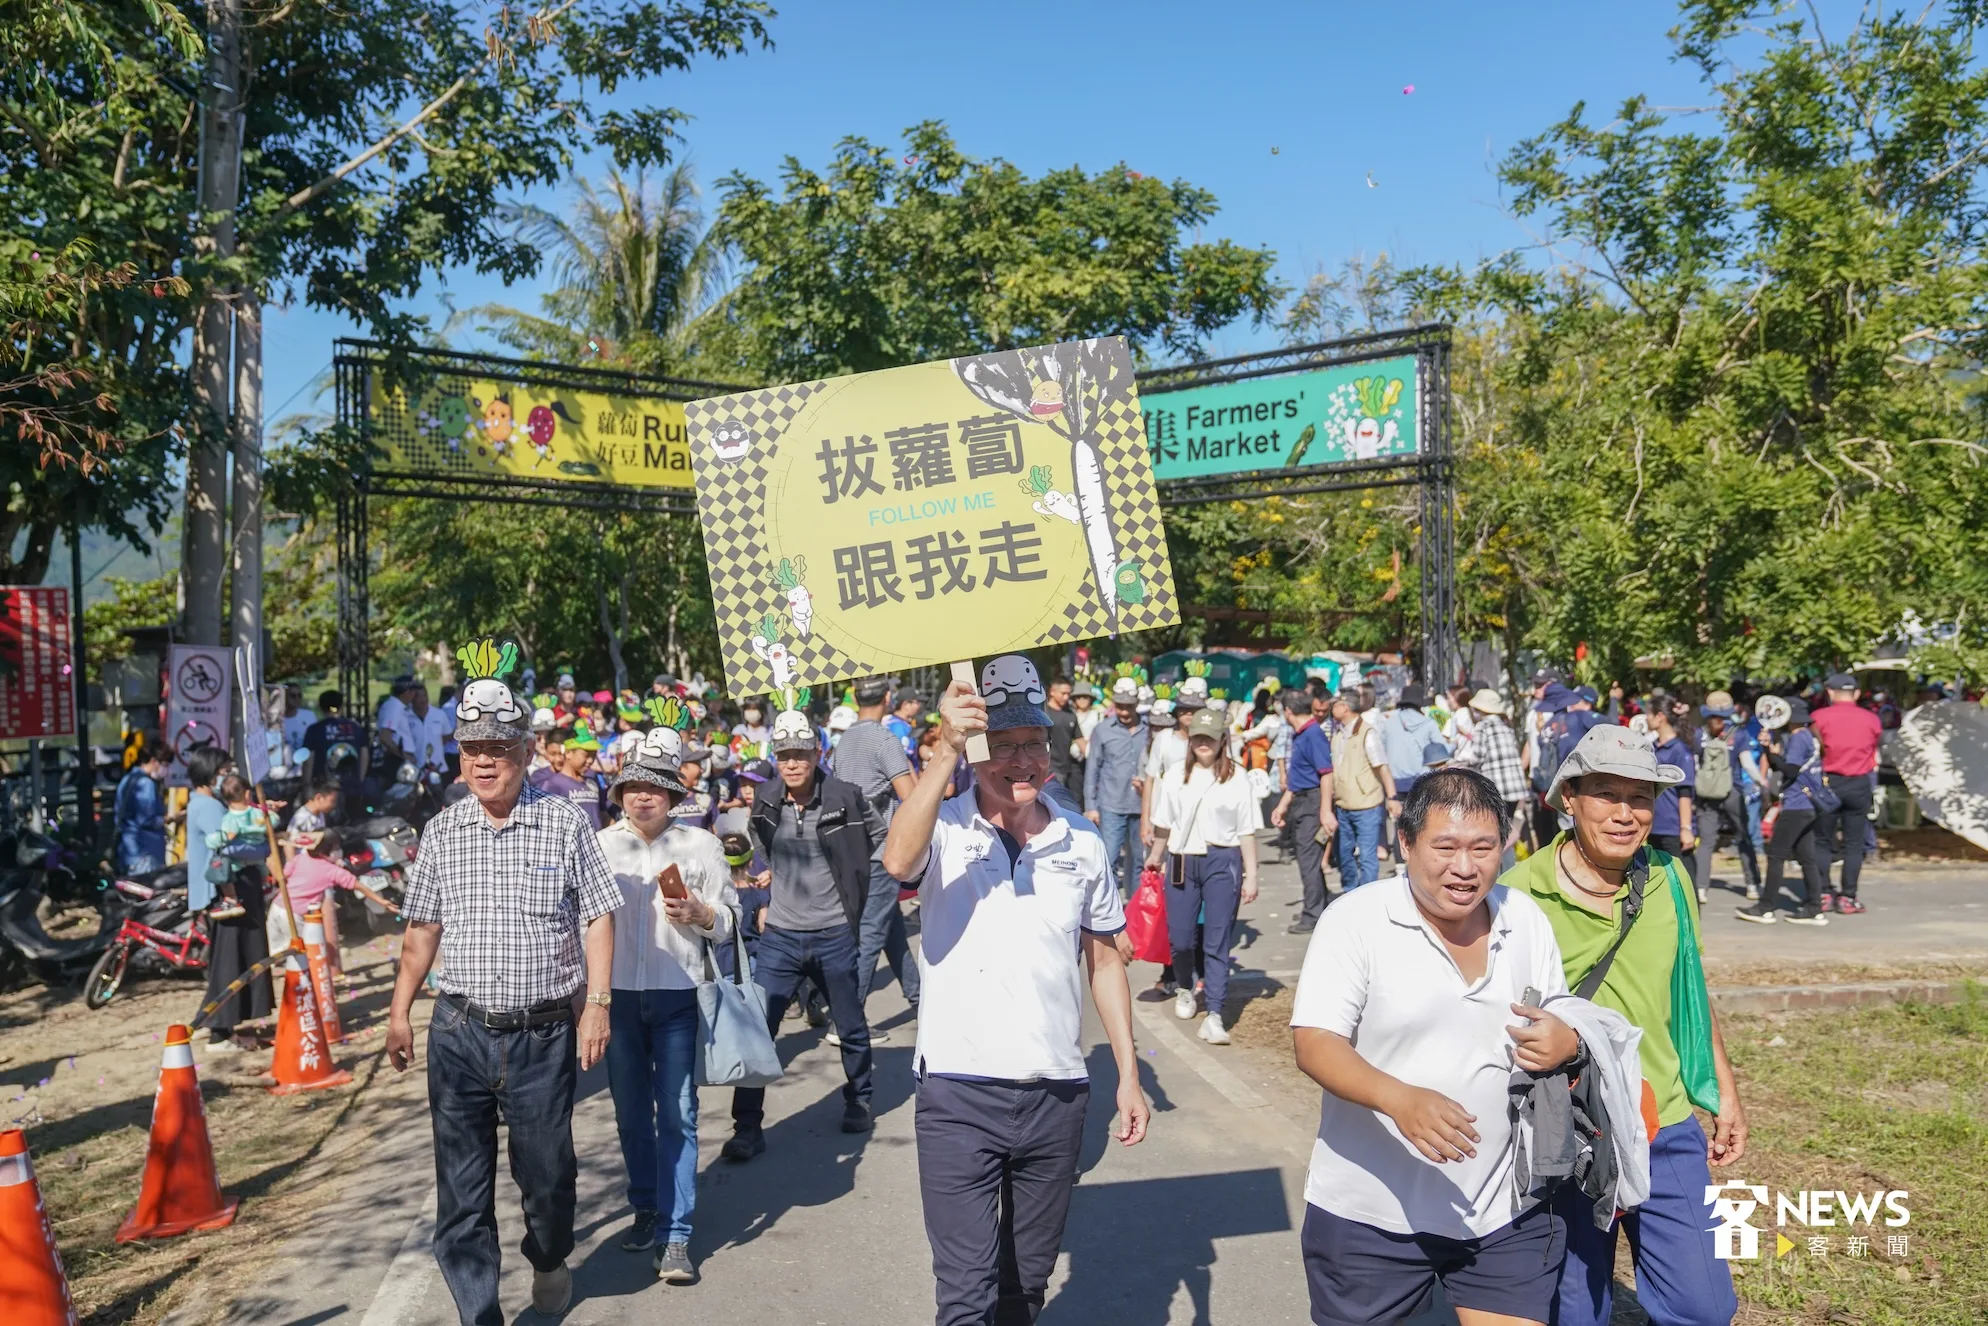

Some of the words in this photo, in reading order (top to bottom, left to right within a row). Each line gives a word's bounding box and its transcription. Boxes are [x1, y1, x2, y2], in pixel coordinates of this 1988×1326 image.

[1186, 390, 1305, 430] Farmers'
[597, 440, 639, 467] 好豆
[1144, 408, 1180, 465] 集
[1186, 429, 1281, 463] Market
[815, 411, 1025, 505] 拔蘿蔔
[868, 498, 958, 526] FOLLOW
[963, 491, 996, 512] ME
[832, 520, 1048, 611] 跟我走
